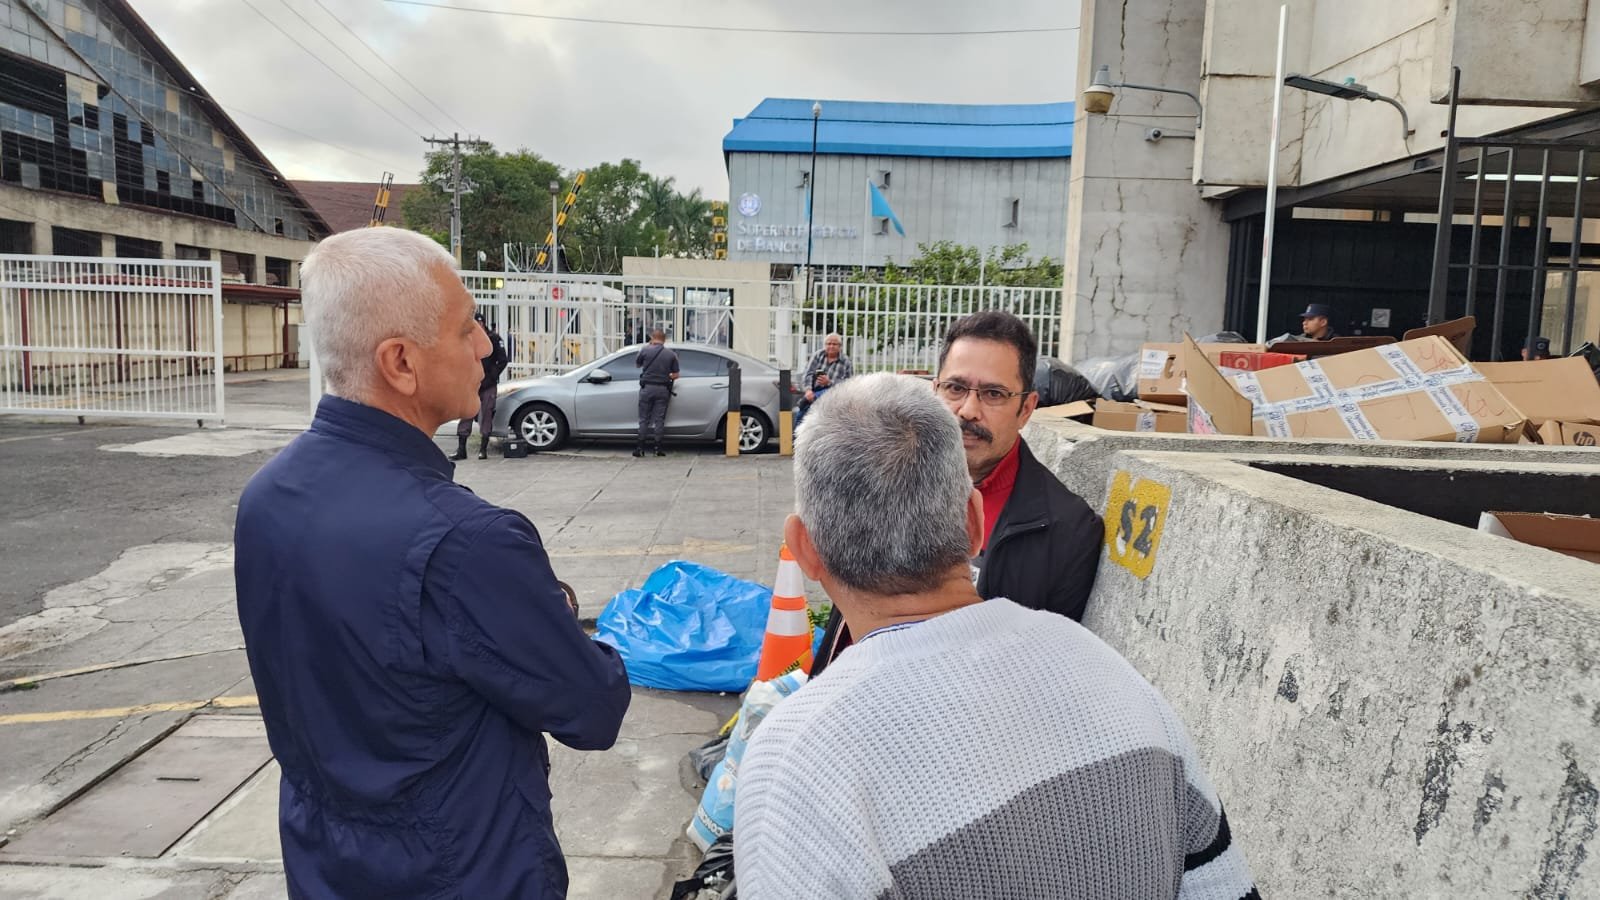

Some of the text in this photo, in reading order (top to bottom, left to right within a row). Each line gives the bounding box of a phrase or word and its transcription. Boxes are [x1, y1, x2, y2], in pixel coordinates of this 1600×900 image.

[736, 239, 753, 252] DE
[1574, 431, 1595, 446] hp
[1116, 500, 1157, 558] S2
